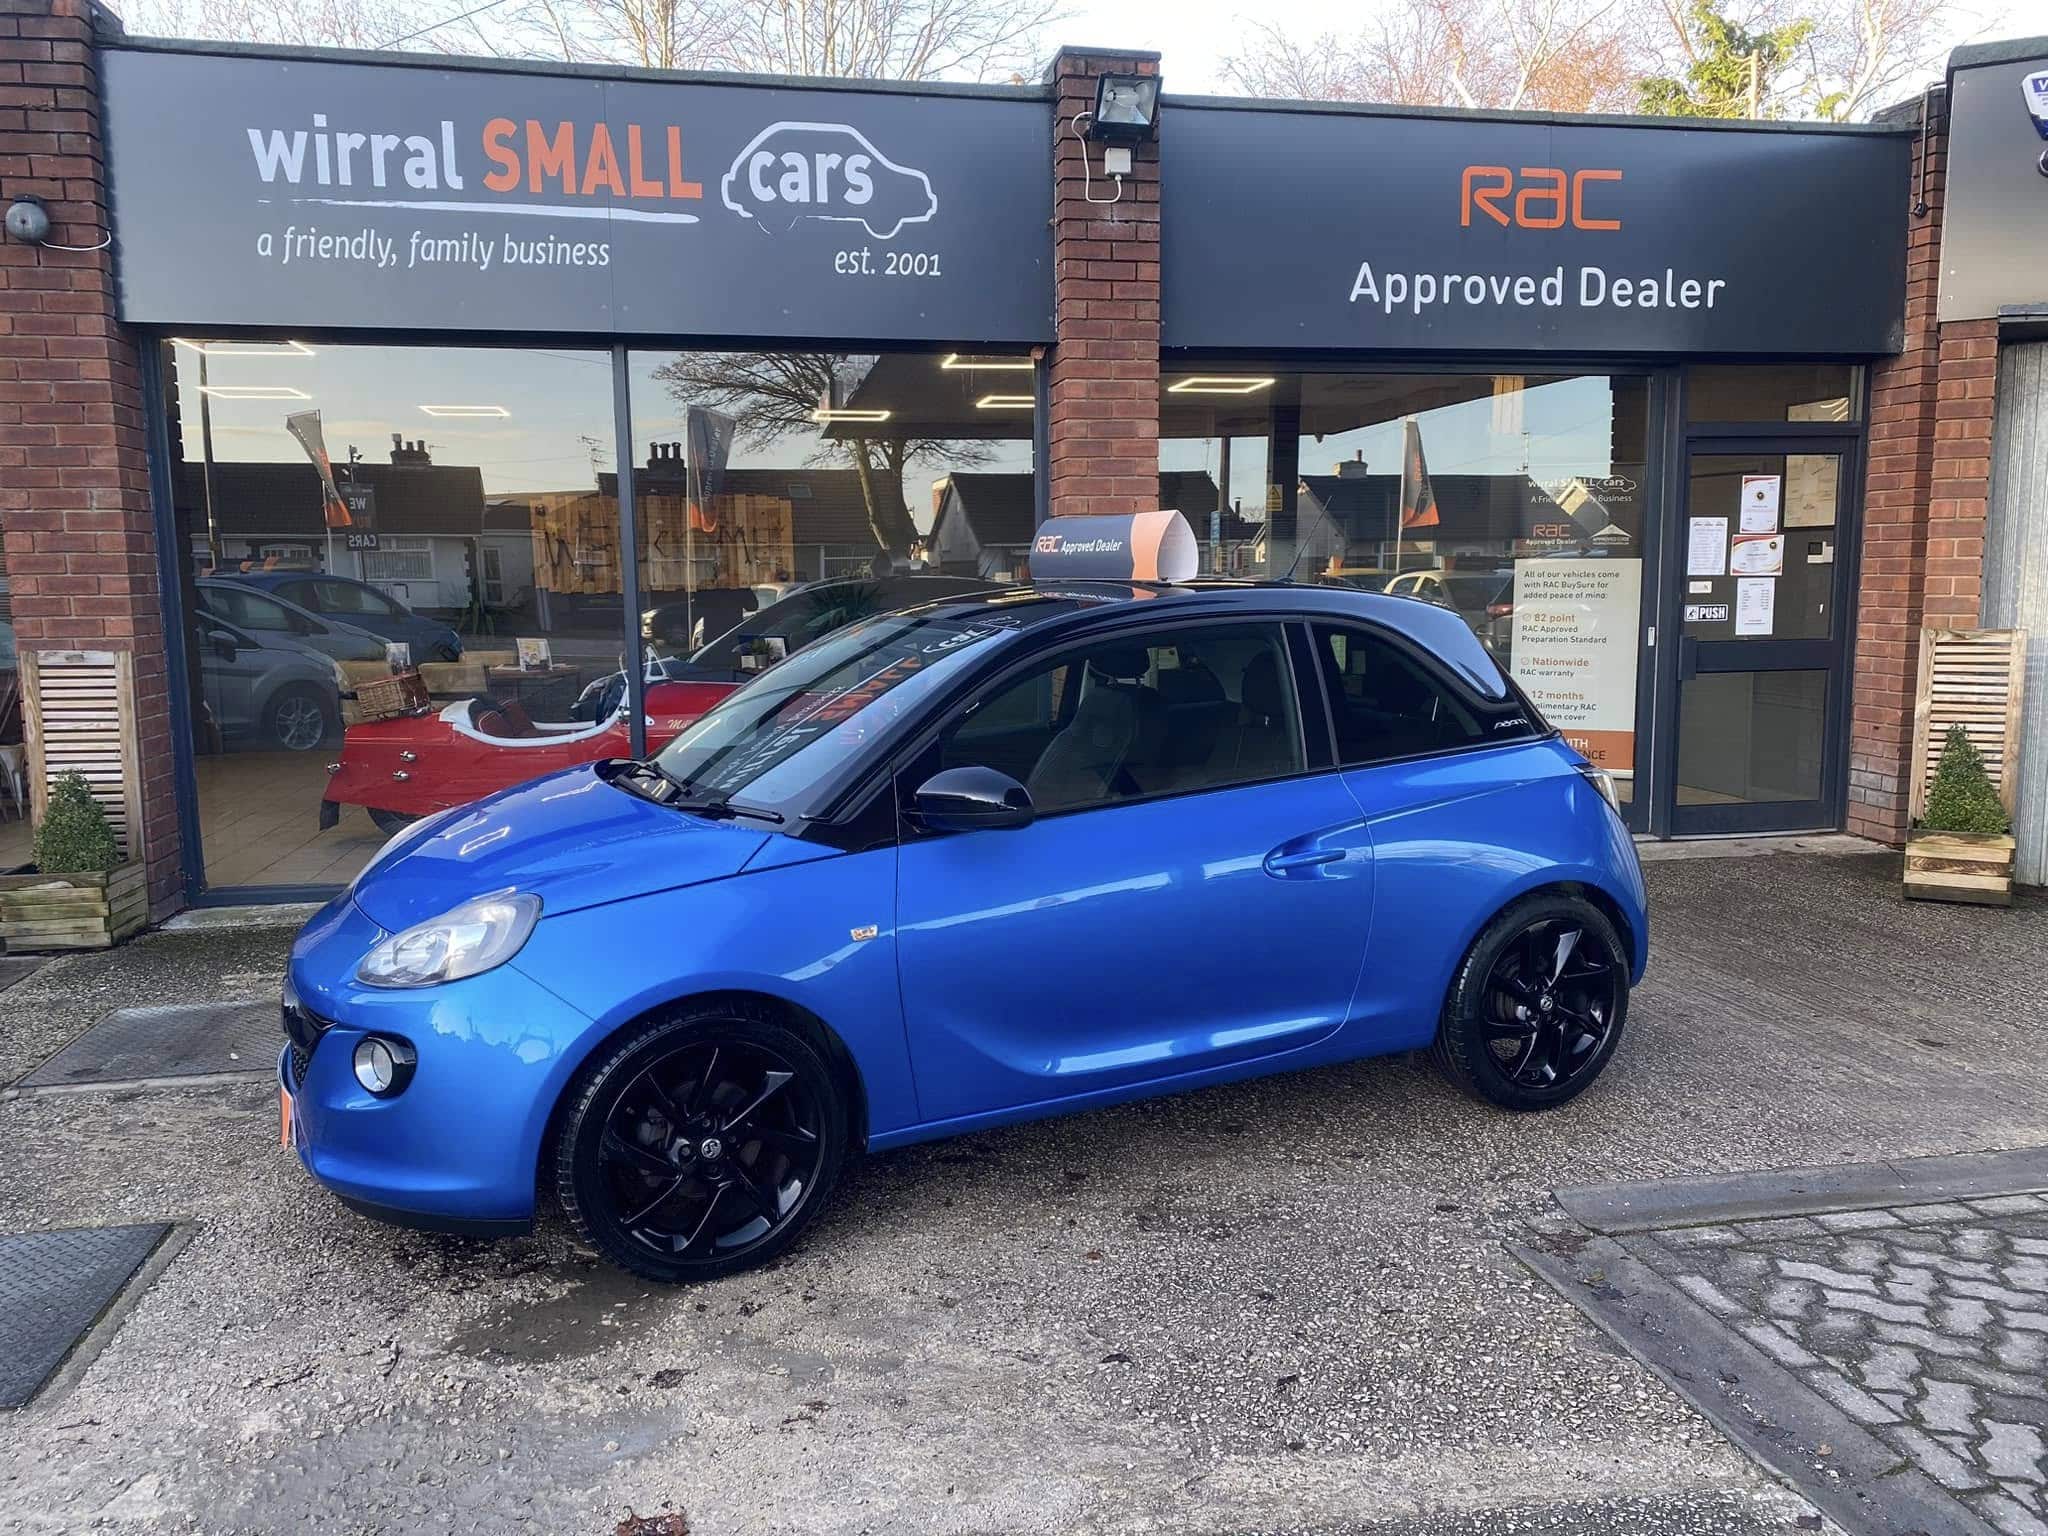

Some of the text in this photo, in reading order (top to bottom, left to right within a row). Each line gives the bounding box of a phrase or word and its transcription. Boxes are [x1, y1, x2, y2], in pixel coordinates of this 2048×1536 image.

[247, 113, 874, 205] wirral SMALL cars
[257, 226, 611, 271] a friendly, family business
[834, 246, 942, 276] est. 2001
[1348, 262, 1726, 315] Approved Dealer
[1603, 479, 1625, 487] cars
[1599, 494, 1633, 503] Business
[1061, 540, 1095, 555] Approved
[1095, 539, 1123, 552] Dealer
[1561, 581, 1595, 590] BuySure
[1549, 593, 1574, 601] peace
[1699, 606, 1726, 619] PUSH
[1534, 614, 1575, 623] 82 point
[1540, 625, 1578, 634] Approved
[1521, 635, 1607, 644] Preparation Standard
[1532, 657, 1590, 667] Nationwide
[1538, 669, 1574, 678] warranty
[1531, 690, 1584, 700] 12 months
[1580, 703, 1597, 711] RAC
